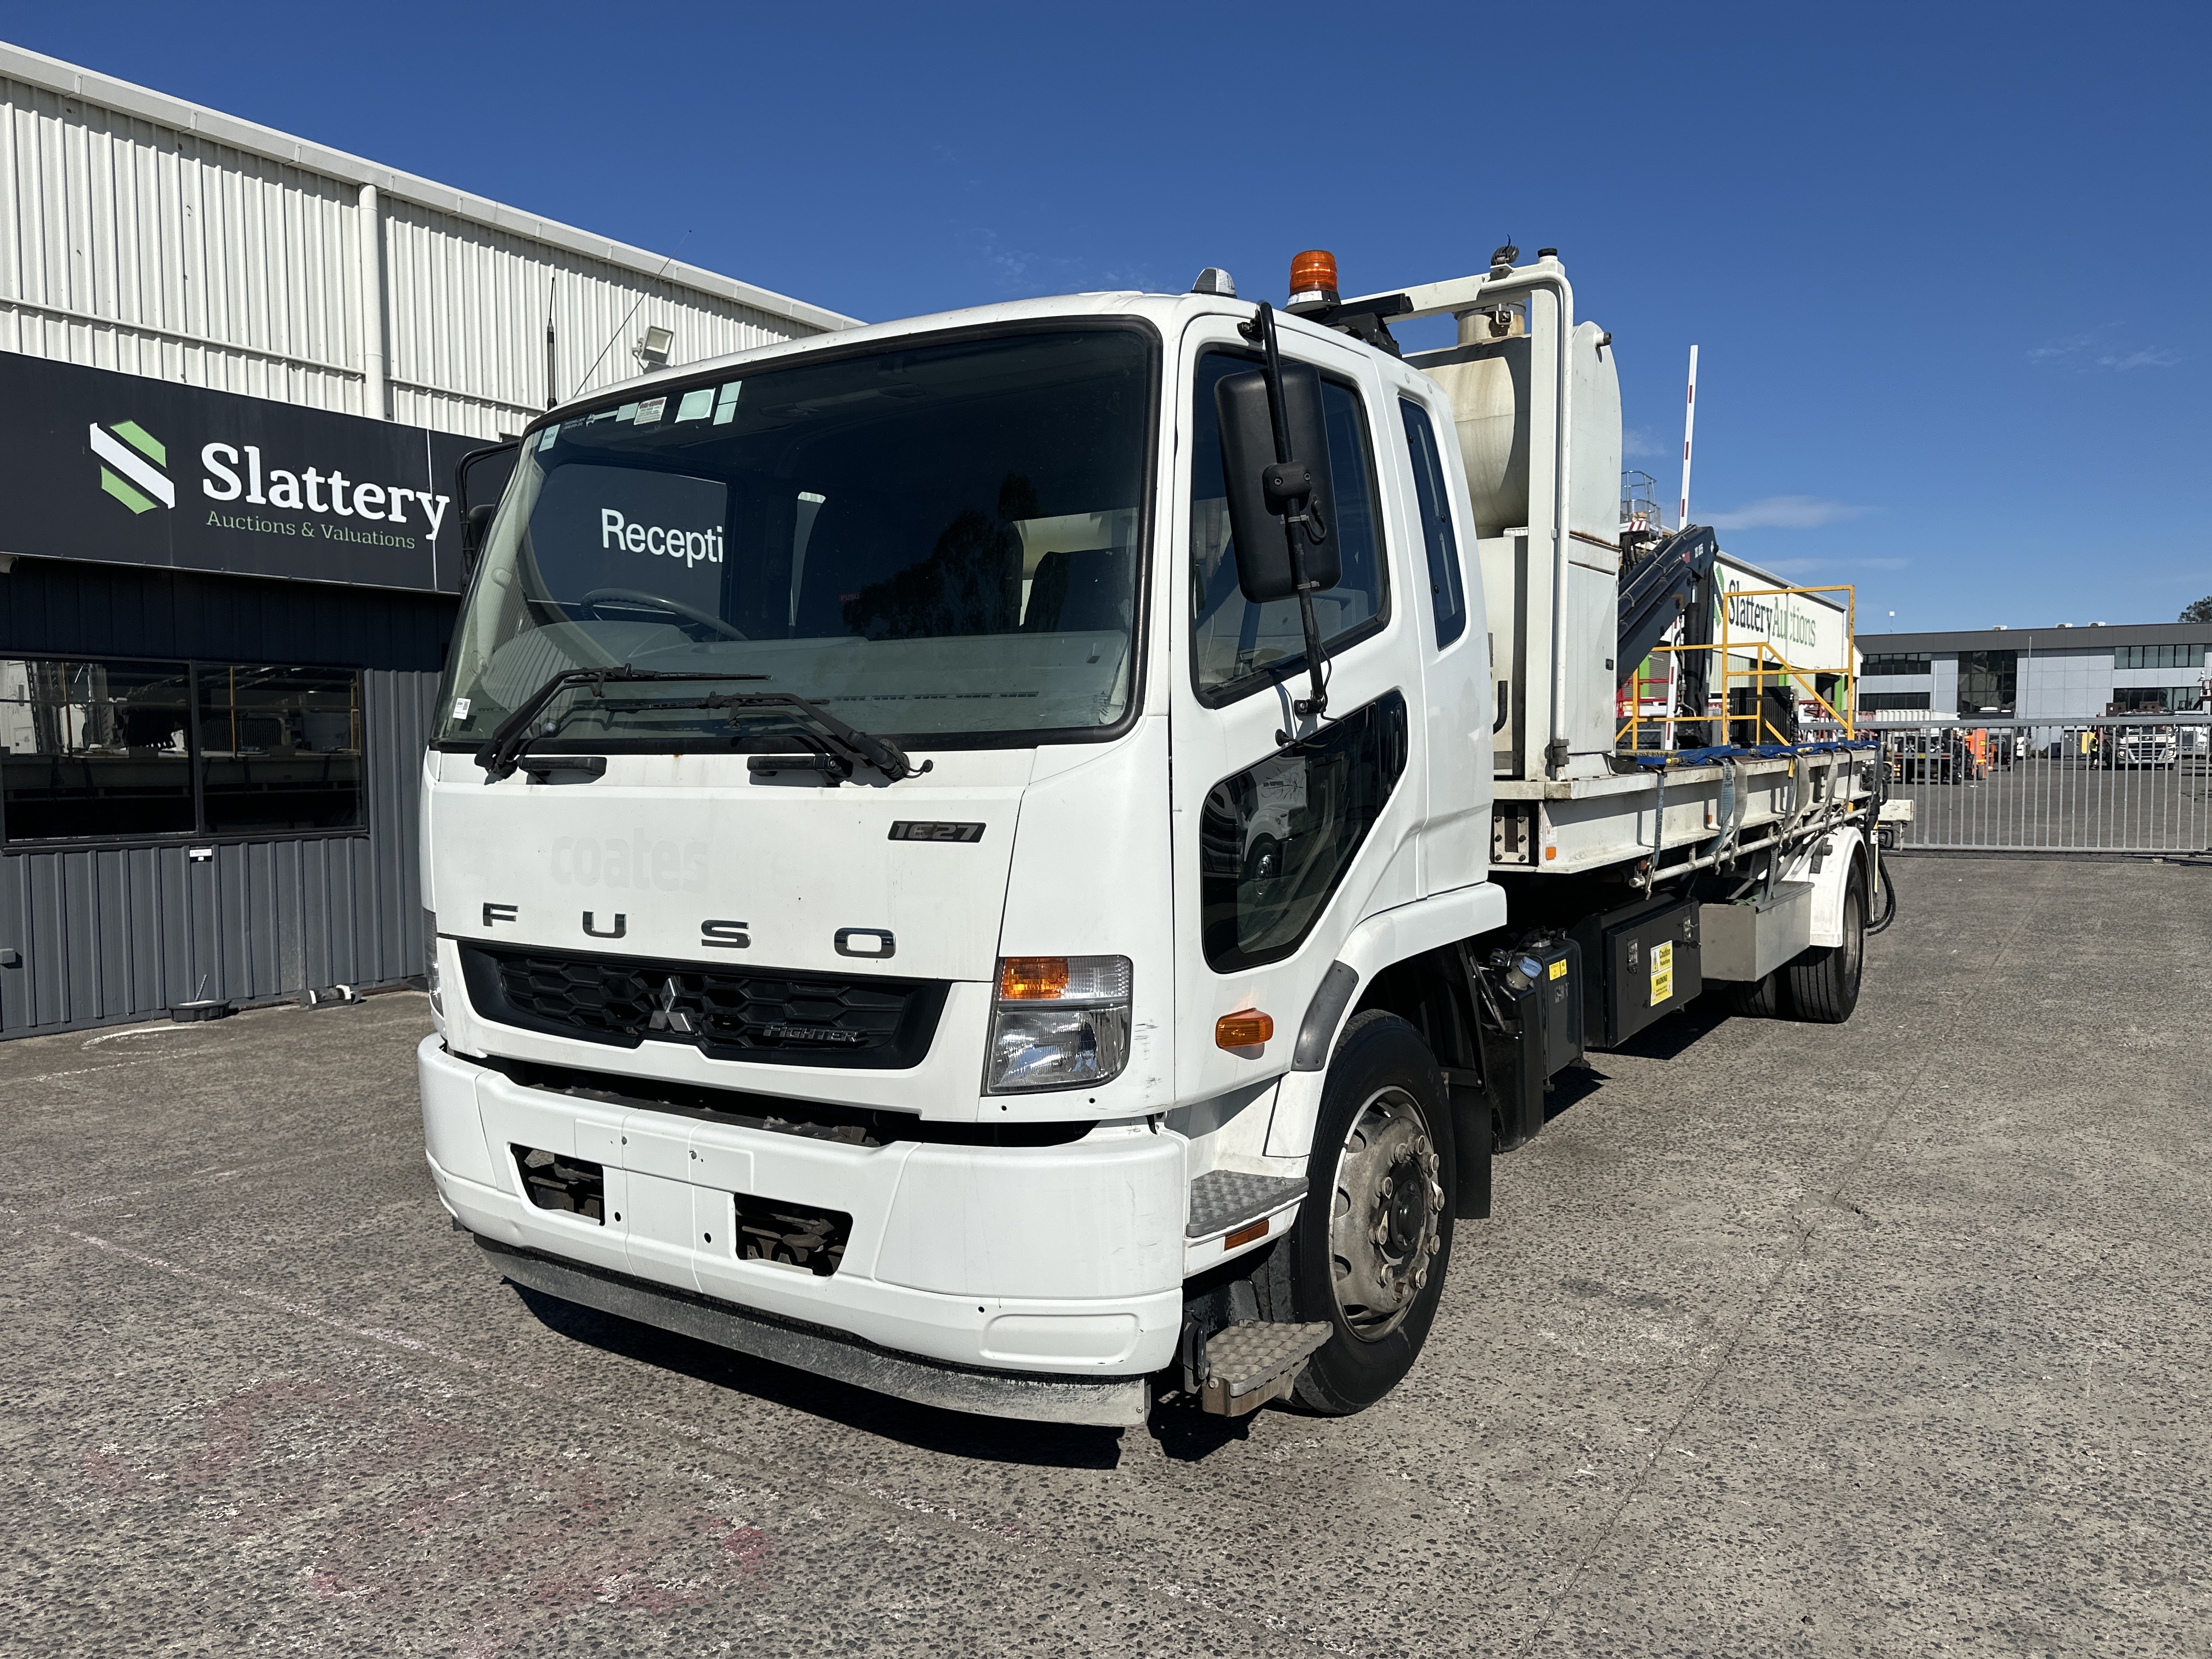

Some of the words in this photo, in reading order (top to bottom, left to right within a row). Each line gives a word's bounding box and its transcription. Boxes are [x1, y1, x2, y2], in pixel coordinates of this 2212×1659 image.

[201, 442, 450, 540] Slattery
[207, 510, 296, 537] Auctions
[301, 522, 314, 537] &
[321, 523, 416, 550] Valuations
[550, 827, 709, 894] coates
[483, 902, 896, 959] FUSO
[763, 1021, 859, 1042] FIGHTER
